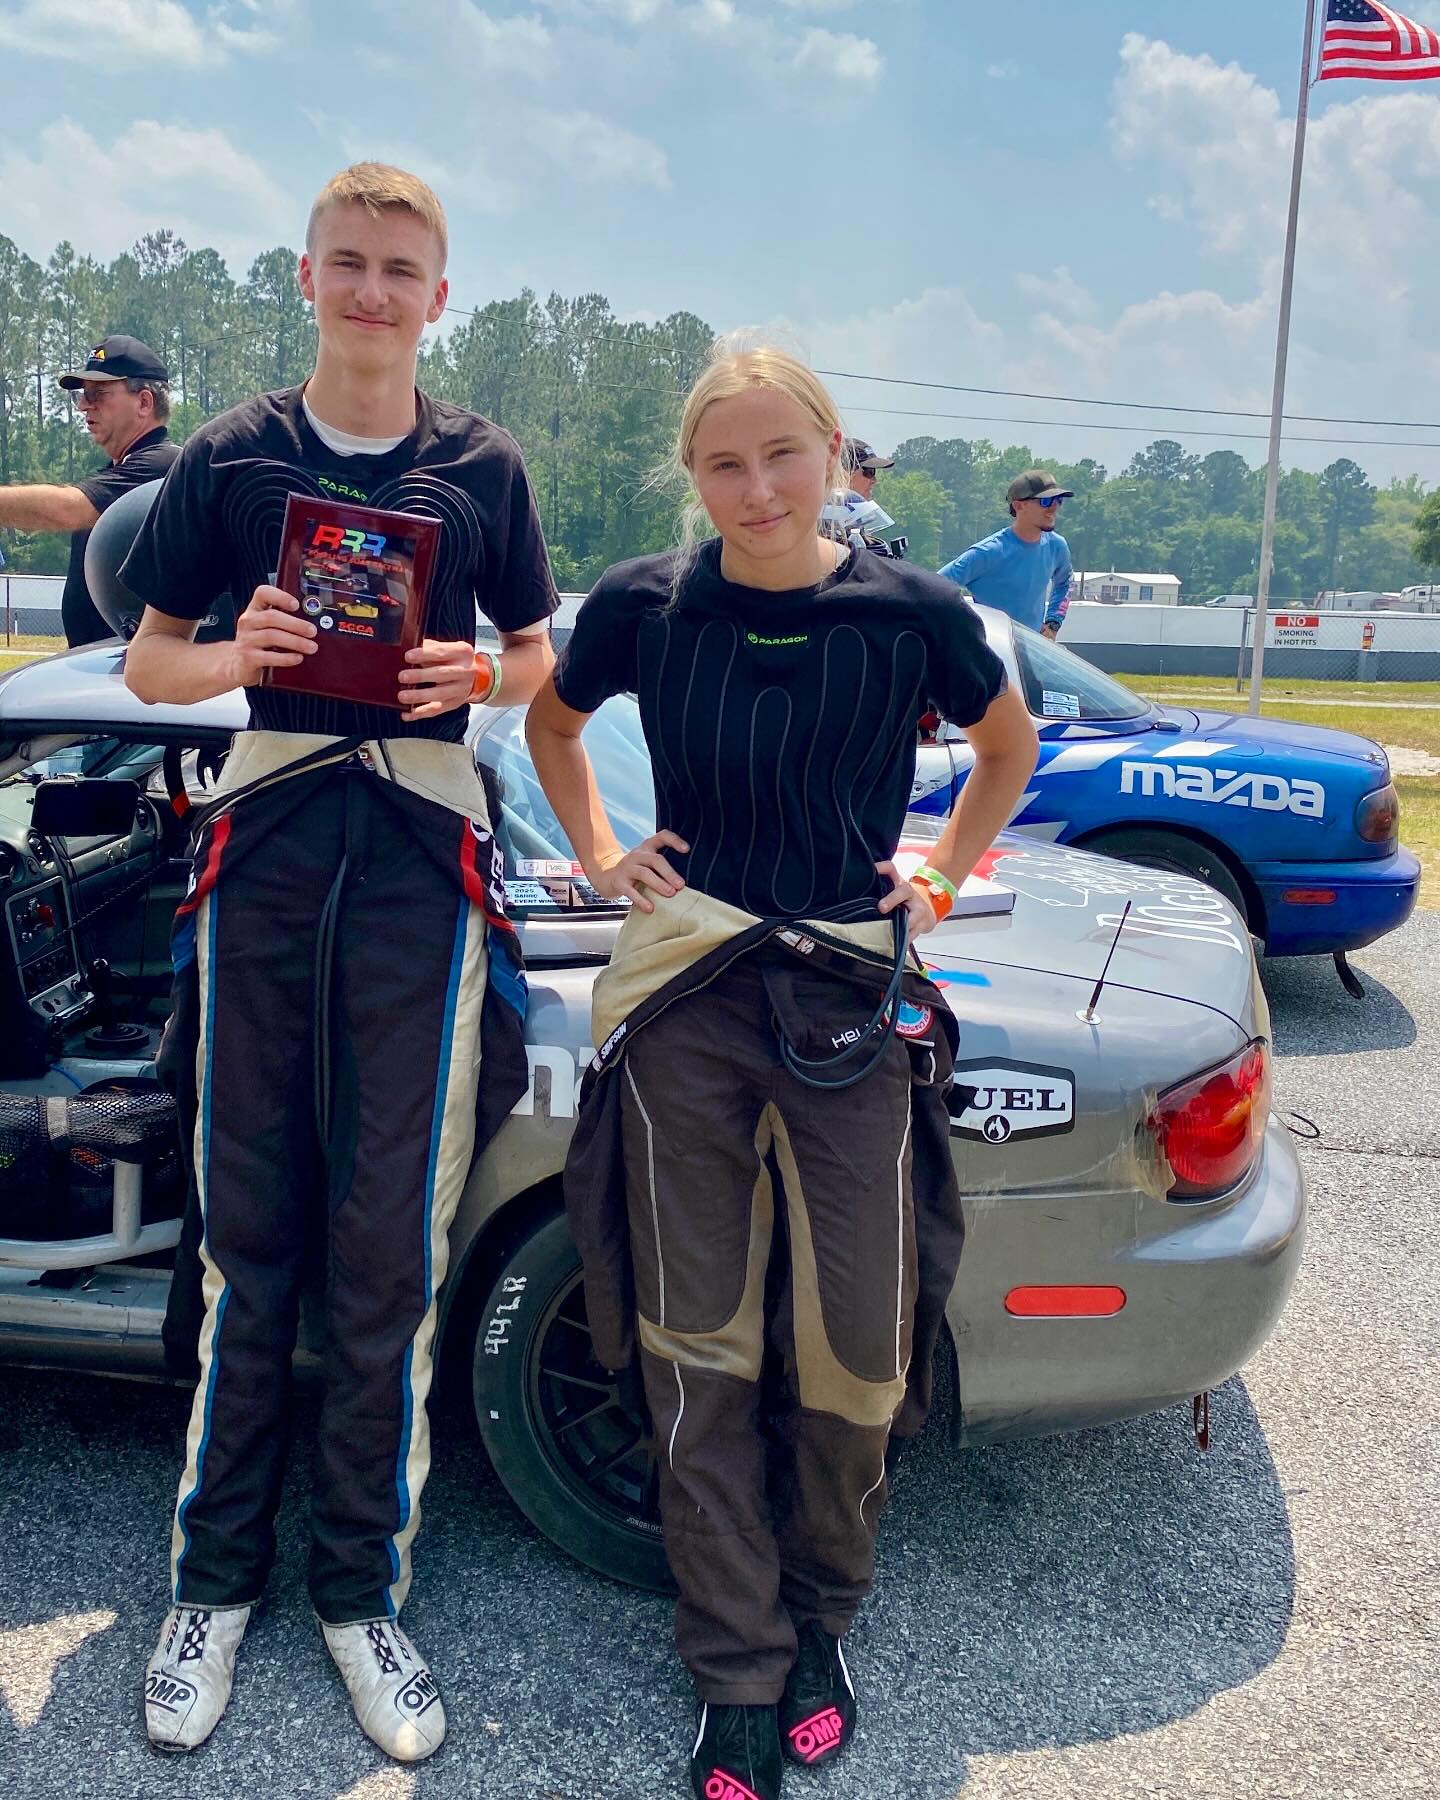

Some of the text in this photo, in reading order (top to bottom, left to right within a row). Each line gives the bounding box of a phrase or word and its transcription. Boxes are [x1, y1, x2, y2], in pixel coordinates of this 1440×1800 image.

[1287, 617, 1307, 627] NO
[758, 635, 808, 645] PARAGON
[1278, 629, 1314, 637] SMOKING
[1120, 760, 1326, 818] mazda
[967, 1087, 1066, 1111] UEL
[794, 1713, 843, 1754] OMP
